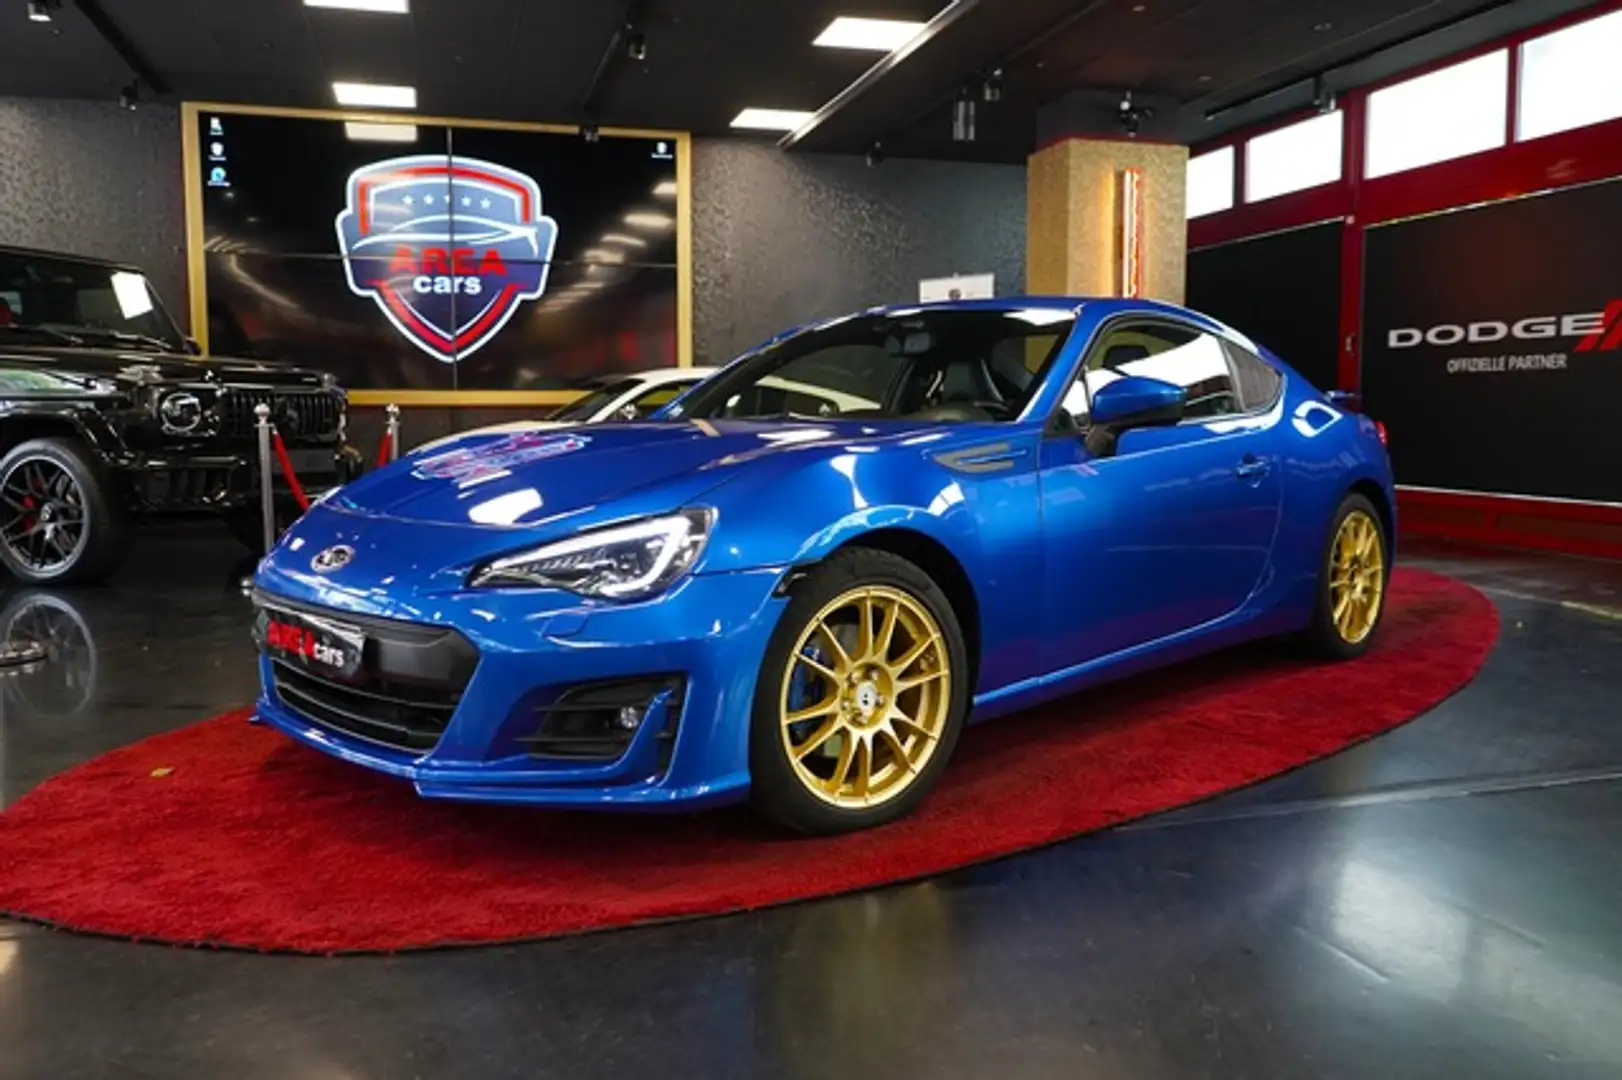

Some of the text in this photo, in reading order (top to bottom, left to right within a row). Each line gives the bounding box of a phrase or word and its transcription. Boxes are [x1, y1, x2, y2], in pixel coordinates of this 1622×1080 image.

[389, 245, 508, 276] AREA
[413, 275, 482, 295] cars
[1388, 312, 1605, 348] DODGE
[1447, 353, 1567, 373] OFFIZIELLE PARTNER
